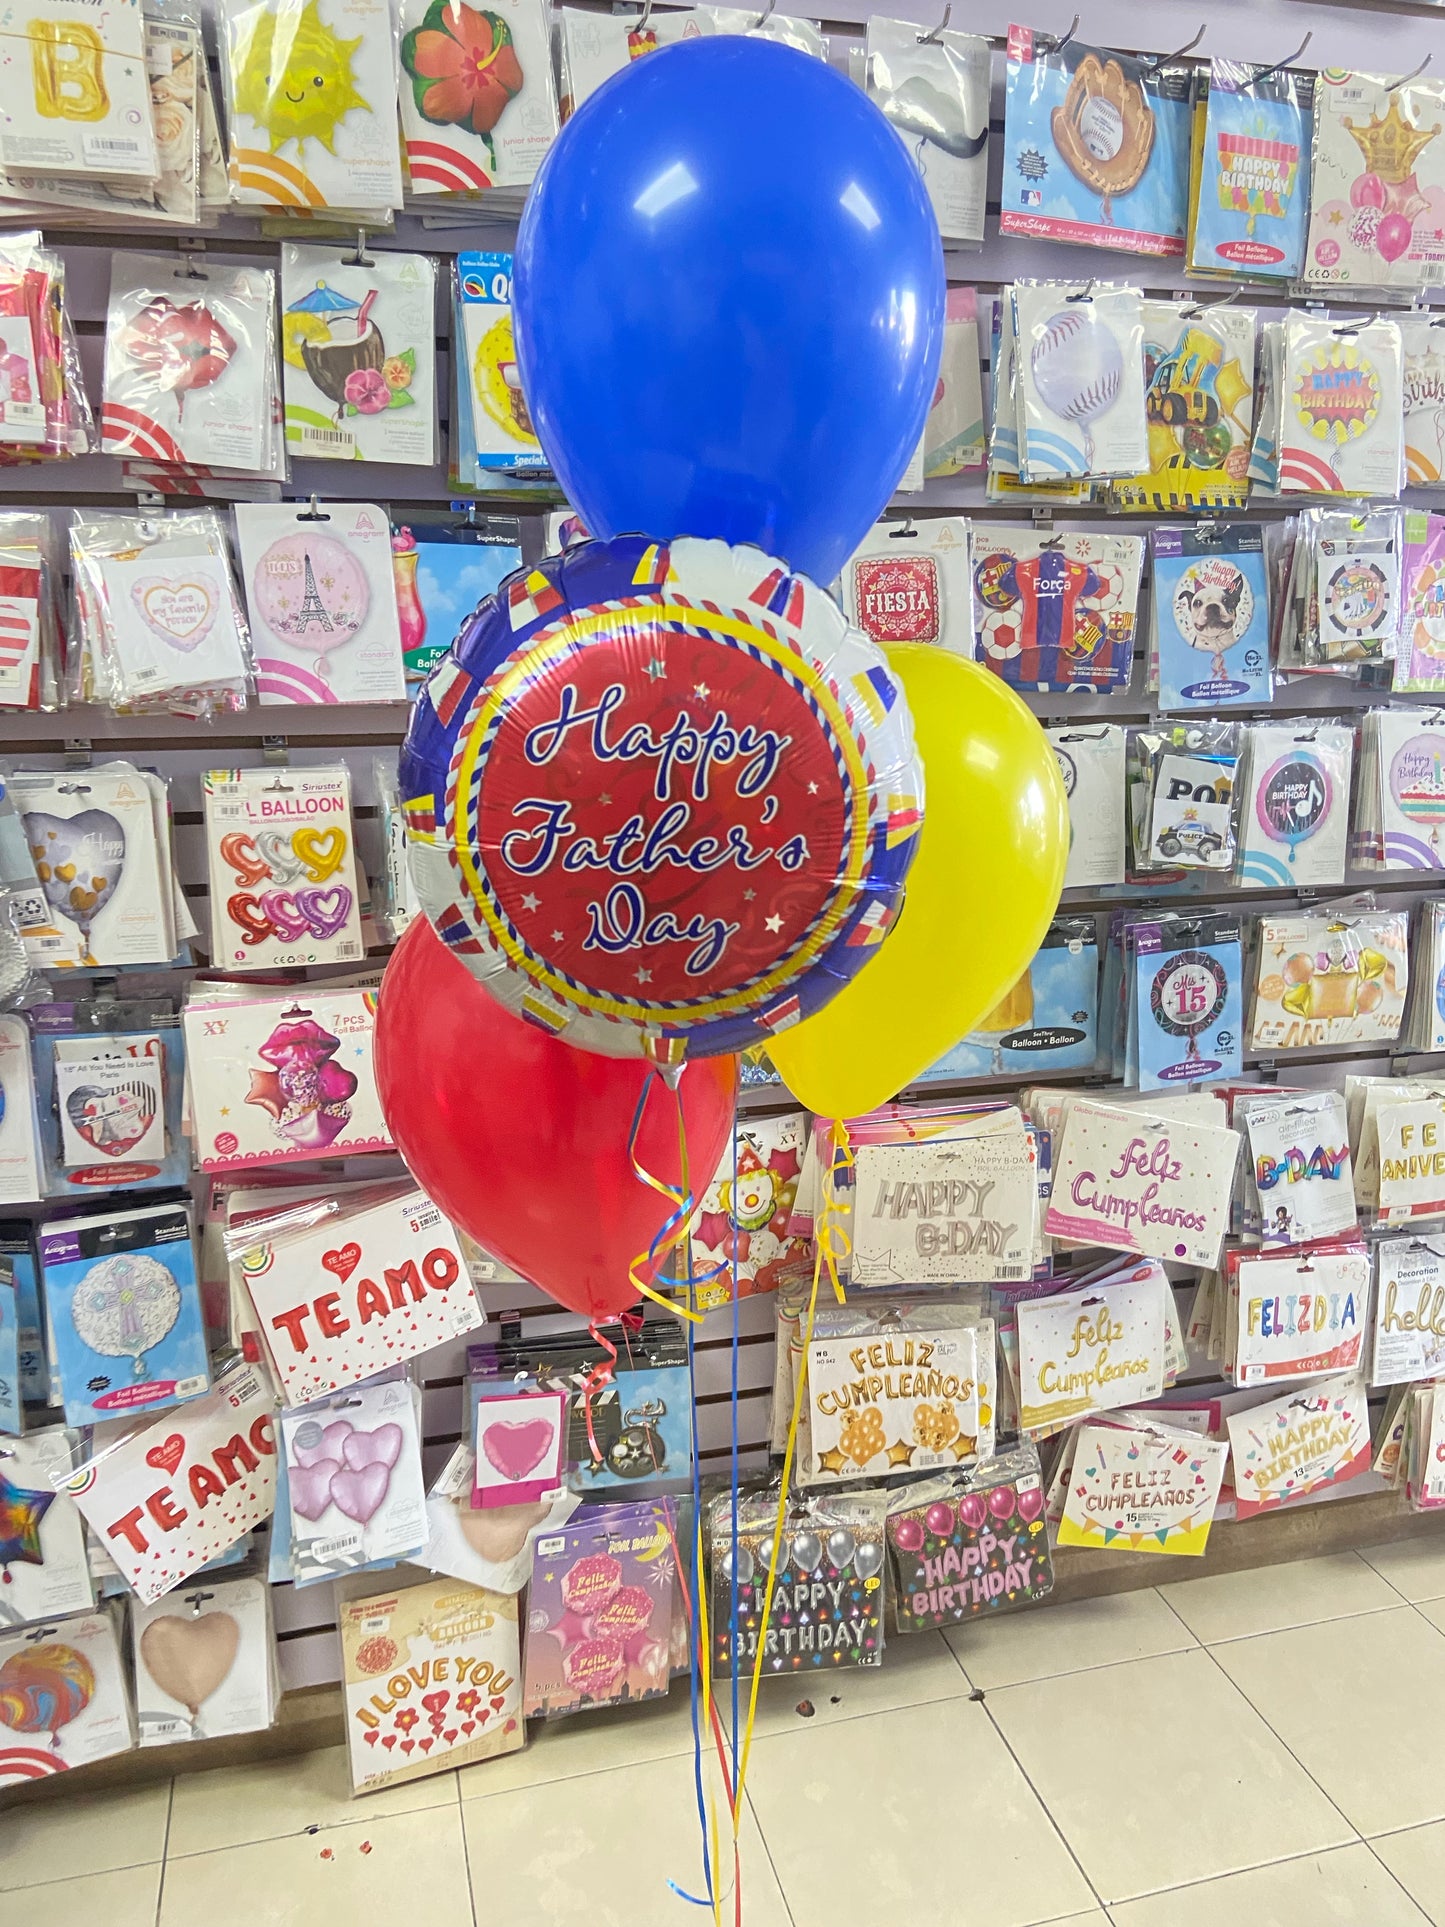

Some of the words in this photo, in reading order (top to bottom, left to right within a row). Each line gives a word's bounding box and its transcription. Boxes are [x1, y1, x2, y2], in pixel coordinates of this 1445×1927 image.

[527, 135, 552, 145] shape
[1232, 156, 1281, 177] HAPPY
[1221, 170, 1290, 194] BIRTHDAY
[1003, 215, 1052, 233] SuperShape
[1226, 251, 1246, 260] Ballon
[1234, 243, 1245, 251] Foil
[1246, 245, 1268, 254] Balloon
[1312, 370, 1364, 391] HAPPY
[1302, 392, 1374, 409] BIRTHDAY
[476, 533, 516, 544] SuperShape
[1155, 540, 1182, 550] Anagram
[1212, 560, 1237, 580] Happy
[1033, 577, 1072, 594] Força
[1202, 571, 1243, 593] Birthday!
[865, 590, 932, 614] FIESTA
[1192, 690, 1210, 699] Ballon
[1211, 688, 1240, 698] métallique
[1199, 684, 1210, 692] Foil
[1211, 682, 1232, 691] Balloon
[523, 682, 792, 801] Happy
[1402, 751, 1430, 767] Happy
[1397, 764, 1434, 782] Birthday
[301, 781, 343, 792] Siriustex
[1271, 789, 1309, 801] BIRTHDAY
[1284, 782, 1309, 793] HAPPY
[261, 796, 345, 817] BALLOON
[500, 795, 811, 877] Father's
[1178, 832, 1204, 840] POLICE
[581, 880, 741, 978] Day
[1214, 928, 1239, 937] Standard
[1266, 929, 1274, 941] 5
[1138, 937, 1161, 947] Anagram
[1173, 974, 1197, 990] Mis
[1175, 985, 1207, 1015] 15
[203, 1018, 229, 1037] XY
[333, 1014, 342, 1027] 7
[343, 1015, 366, 1026] PCS
[333, 1025, 347, 1035] Foil
[1011, 1037, 1042, 1049] Balloon
[1049, 1035, 1075, 1046] Ballon
[135, 1060, 155, 1068] Love
[1174, 1065, 1185, 1073] Foil
[1185, 1062, 1206, 1071] Balloon
[1167, 1071, 1185, 1079] Ballon
[1073, 1105, 1094, 1116] Globo
[974, 1157, 1001, 1165] HAPPY
[1004, 1156, 1030, 1165] B-DAY
[1110, 1138, 1184, 1184] Feliz
[872, 1179, 996, 1220] HAPPY
[1070, 1171, 1207, 1232] Cumpleaños
[409, 1219, 421, 1233] 5
[418, 1213, 442, 1228] smile!
[155, 1223, 188, 1236] Standard
[44, 1243, 79, 1256] Anagram
[327, 1256, 338, 1266] TE
[338, 1249, 357, 1262] AMO
[1396, 1265, 1439, 1279] Decoration
[271, 1291, 351, 1355] TE
[356, 1247, 459, 1326] AMO
[1066, 1306, 1124, 1358] Feliz
[849, 1339, 935, 1374] FELIZ
[1037, 1347, 1150, 1396] Cumpleaños
[116, 1389, 129, 1399] Foil
[131, 1383, 161, 1395] Balloon
[816, 1369, 975, 1416] CUMPLEAÑOS
[107, 1396, 132, 1408] Ballon
[228, 1394, 240, 1408] 5
[1267, 1413, 1335, 1456] HAPPY
[1252, 1422, 1356, 1491] BIRTHDAY
[1111, 1468, 1171, 1490] FELIZ
[1293, 1467, 1304, 1478] 13
[107, 1486, 189, 1555] TE
[187, 1413, 278, 1510] AMO
[1085, 1486, 1195, 1513] CUMPLEAÑOS
[1125, 1512, 1137, 1522] 15
[608, 1539, 631, 1554] FOIL
[631, 1534, 672, 1551] BALLOON
[922, 1532, 1019, 1589] HAPPY
[568, 1578, 616, 1598] Cumpleaños
[576, 1572, 606, 1589] Feliz
[911, 1556, 1035, 1617] BIRTHDAY
[755, 1580, 845, 1613] HAPPY
[608, 1603, 637, 1617] Feliz
[599, 1613, 648, 1625] Cumpleaños
[733, 1616, 869, 1658] BIRTHDAY
[570, 1660, 620, 1679] Cumpleaños
[579, 1652, 607, 1670] Feliz
[370, 1656, 450, 1714] LOVE
[454, 1655, 516, 1696] YOU
